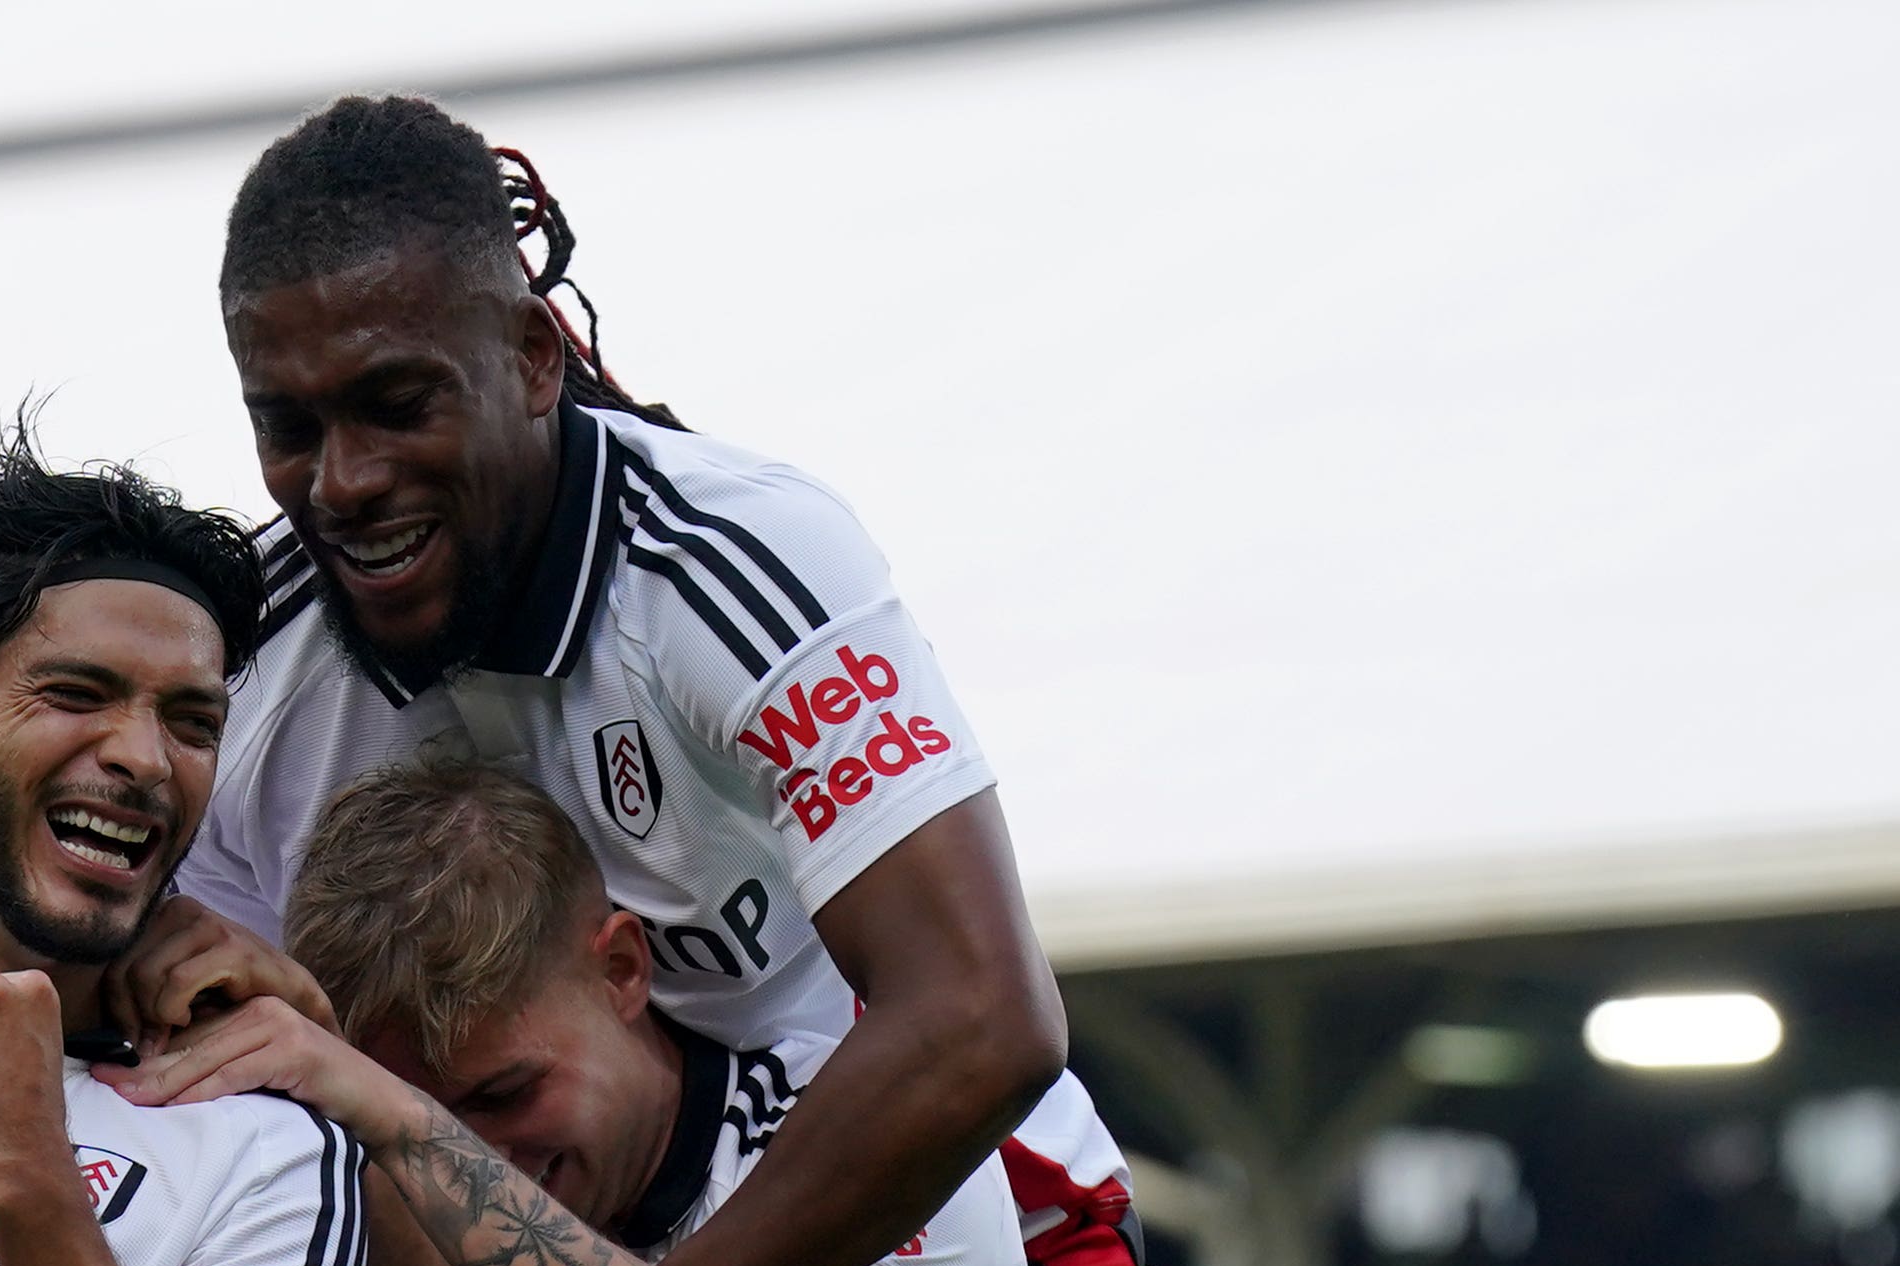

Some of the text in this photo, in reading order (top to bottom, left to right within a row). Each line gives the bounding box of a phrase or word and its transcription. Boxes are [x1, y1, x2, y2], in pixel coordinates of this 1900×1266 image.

[736, 645, 900, 771] Web
[610, 734, 646, 818] FFC
[780, 711, 951, 843] Beds
